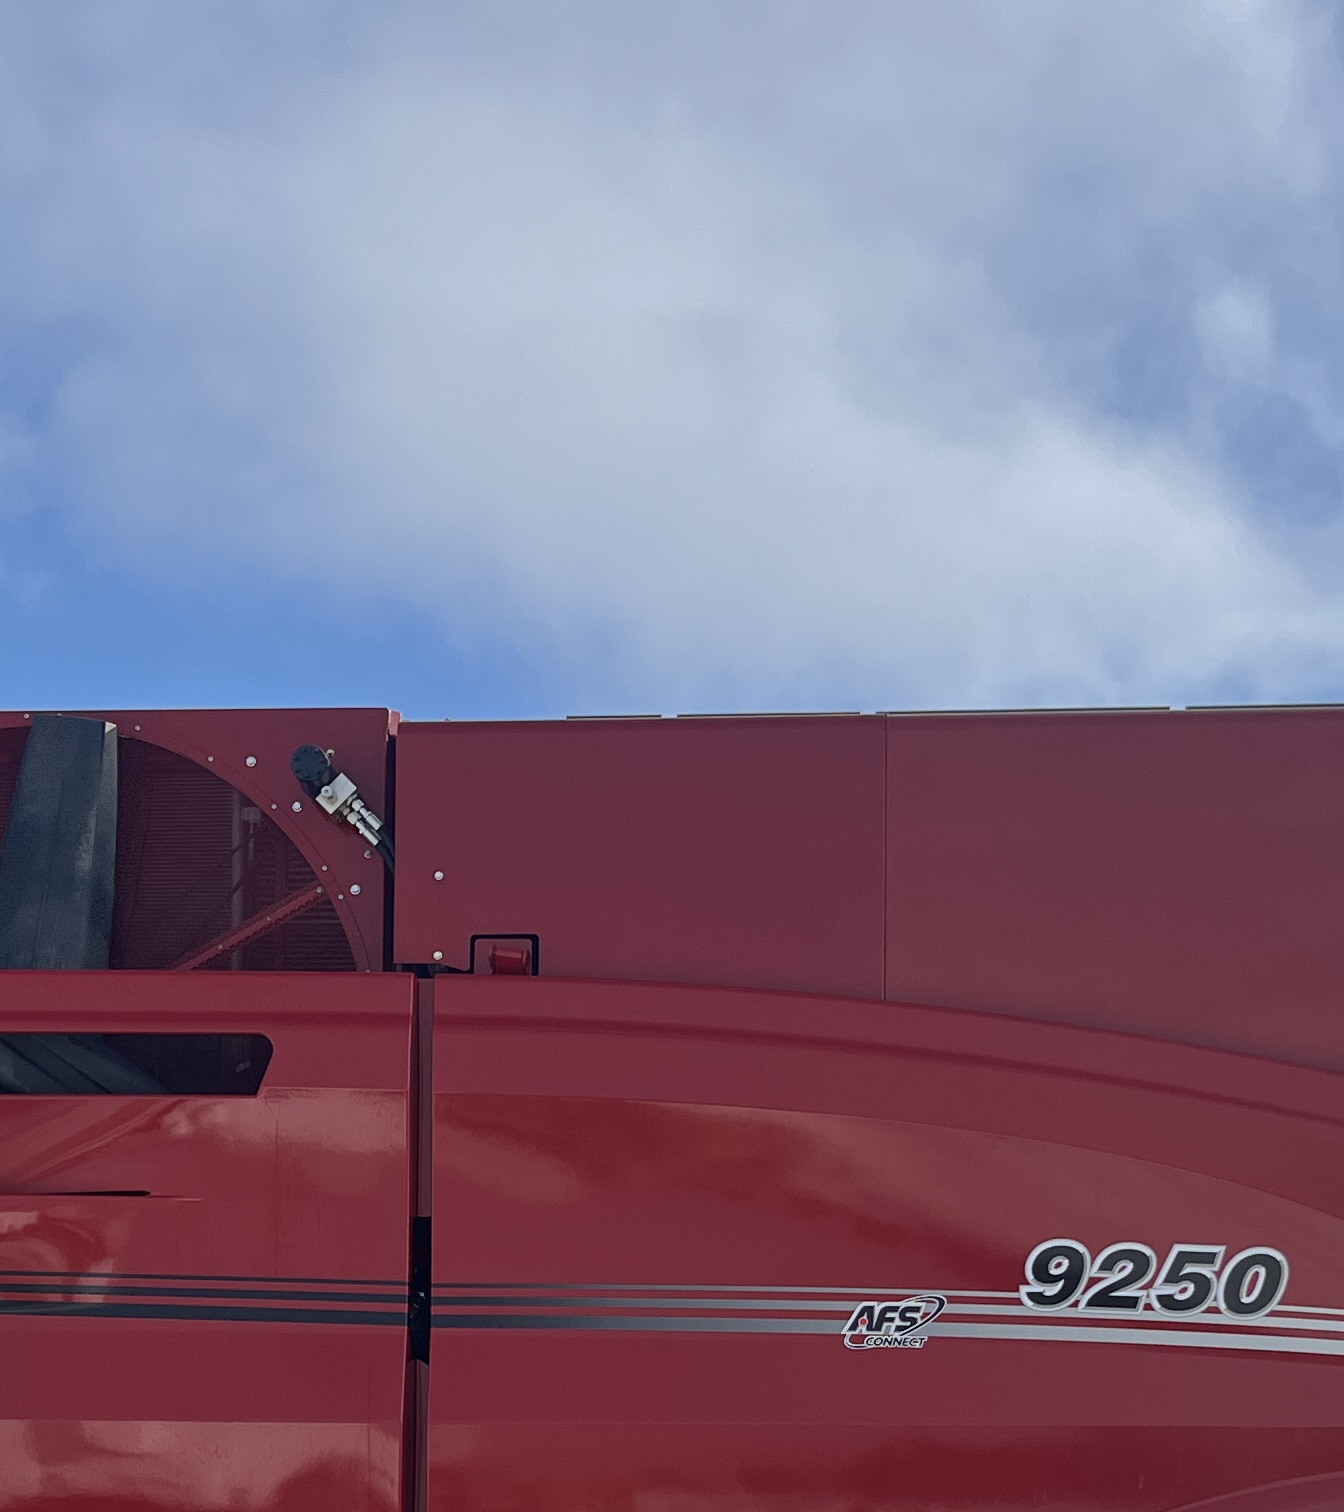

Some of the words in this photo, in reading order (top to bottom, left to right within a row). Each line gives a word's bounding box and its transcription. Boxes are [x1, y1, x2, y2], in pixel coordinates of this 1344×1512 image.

[1019, 1238, 1290, 1320] 9250
[843, 1302, 925, 1334] AFS
[866, 1336, 927, 1348] CONNECT
